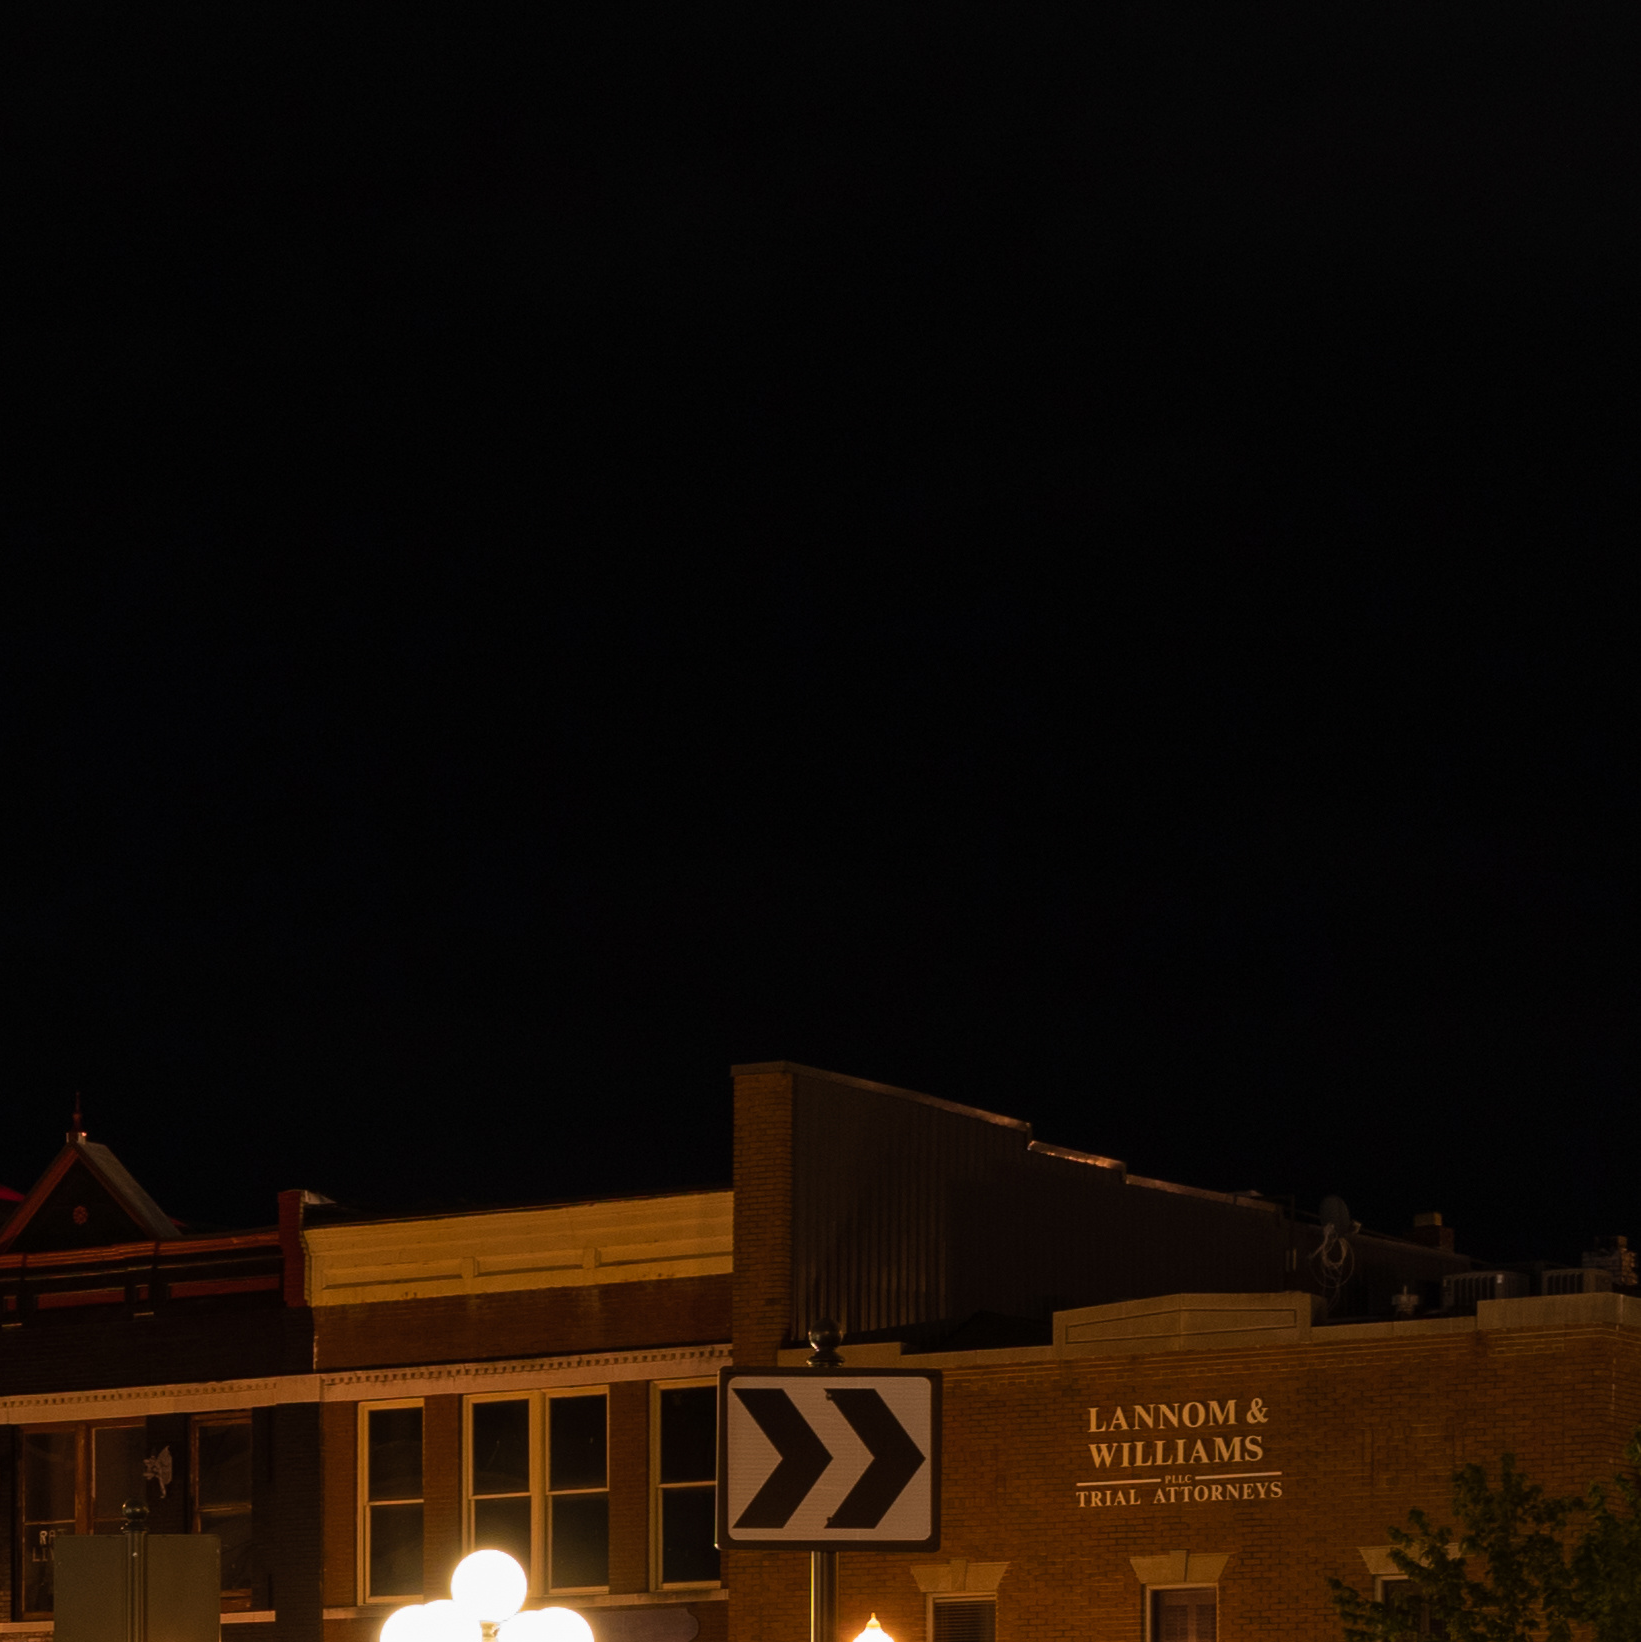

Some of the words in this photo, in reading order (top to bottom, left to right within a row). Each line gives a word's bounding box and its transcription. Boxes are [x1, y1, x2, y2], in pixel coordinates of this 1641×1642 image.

[1088, 1400, 1237, 1433] LANNOM
[1246, 1398, 1270, 1425] &
[1089, 1435, 1263, 1468] WILLIAMS
[1076, 1489, 1141, 1508] TRIAL
[1153, 1481, 1283, 1504] ATTORNEYS
[1165, 1474, 1193, 1485] PLLC
